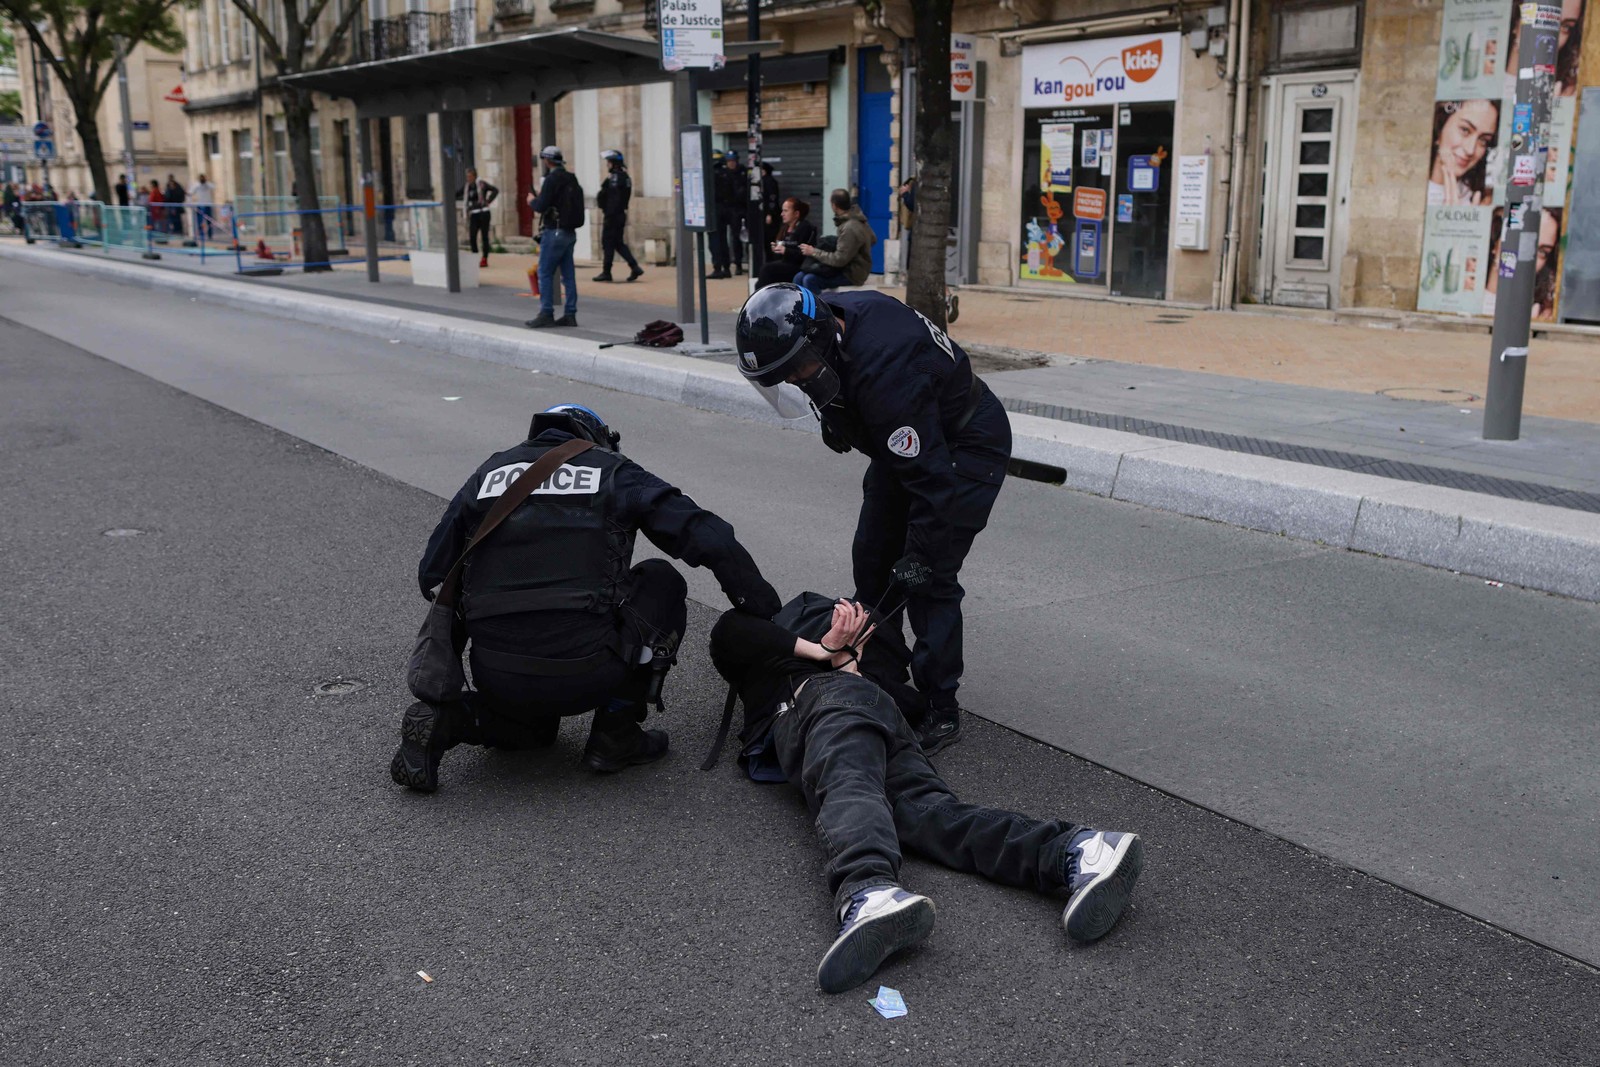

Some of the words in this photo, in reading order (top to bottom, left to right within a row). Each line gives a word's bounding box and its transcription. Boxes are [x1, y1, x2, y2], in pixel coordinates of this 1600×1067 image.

[662, 0, 697, 11] Palais
[663, 14, 677, 25] de
[681, 14, 720, 26] Justice
[955, 39, 972, 49] kan
[1125, 49, 1159, 71] kids
[485, 467, 593, 494] POICE
[897, 569, 918, 581] BLACK
[906, 575, 927, 587] SOUL
